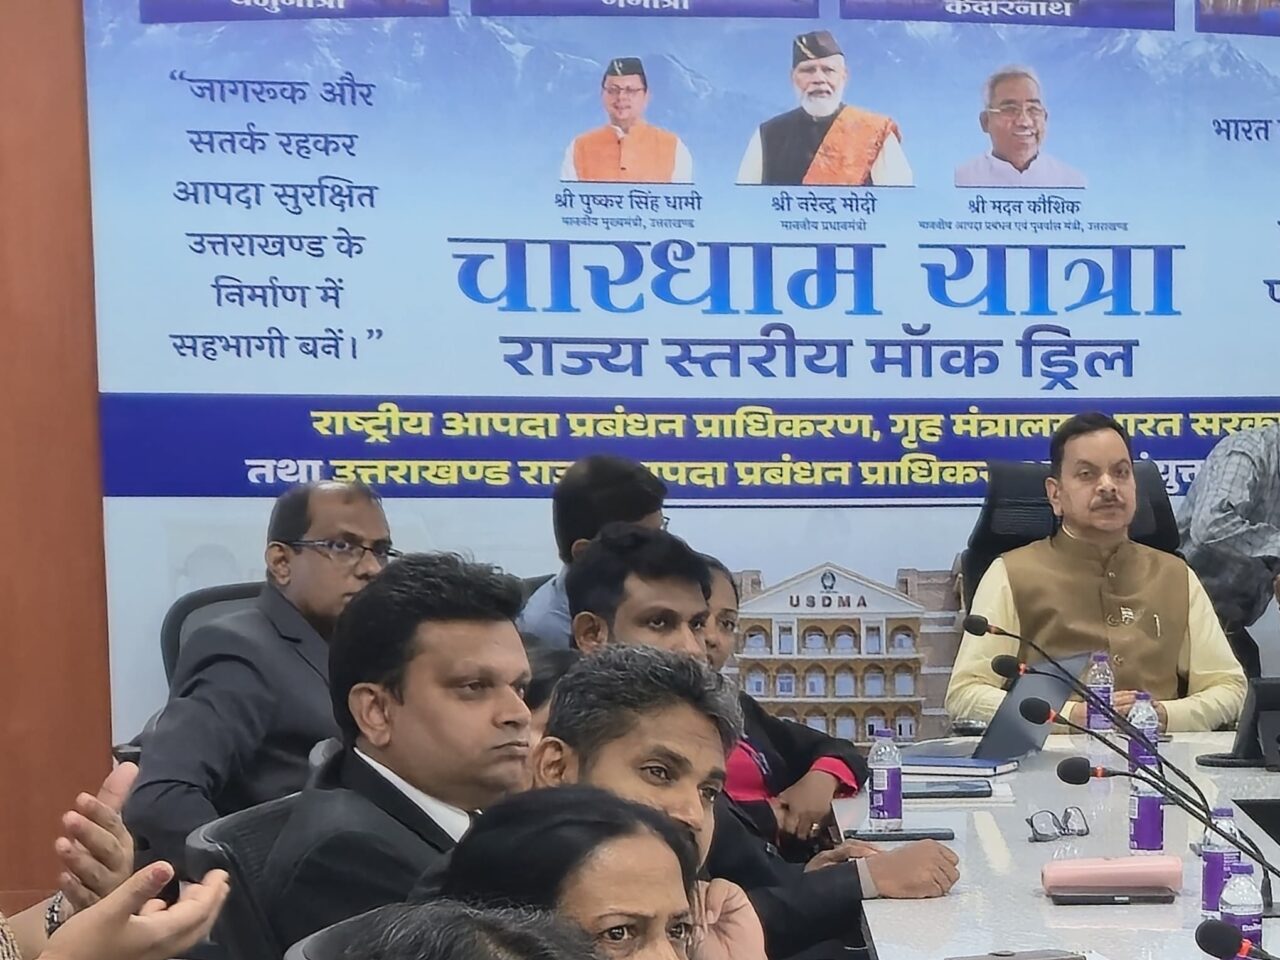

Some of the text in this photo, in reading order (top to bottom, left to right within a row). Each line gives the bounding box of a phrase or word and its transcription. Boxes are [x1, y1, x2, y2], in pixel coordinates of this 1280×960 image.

[320, 71, 376, 107] और
[186, 122, 358, 158] सतर्क रहकर
[1211, 116, 1272, 143] भारत
[173, 176, 379, 215] आपदा सुरक्षित
[554, 188, 703, 214] श्री पुष्कर सिंह धामी
[771, 190, 878, 215] श्री नरेन्द्र मोदी
[968, 193, 1083, 217] श्री मदन कौशिक
[185, 227, 366, 259] उत्तराखण्ड के
[211, 274, 344, 308] निर्माण में
[447, 236, 1186, 317] चारधाम यात्रा
[170, 325, 288, 360] सहभागी
[498, 321, 1139, 391] राज्य स्तरीय मॉक ड्रिल
[310, 402, 434, 445] राष्ट्रीय
[441, 411, 559, 441] आपदा
[566, 405, 687, 440] प्रबंधन
[889, 412, 946, 450] गृह
[951, 405, 1076, 438] मंत्राल
[244, 458, 324, 484] तथा
[328, 459, 512, 487] उत्तराखण्ड
[734, 453, 853, 486] प्रबंधन
[790, 596, 868, 608] USDMA
